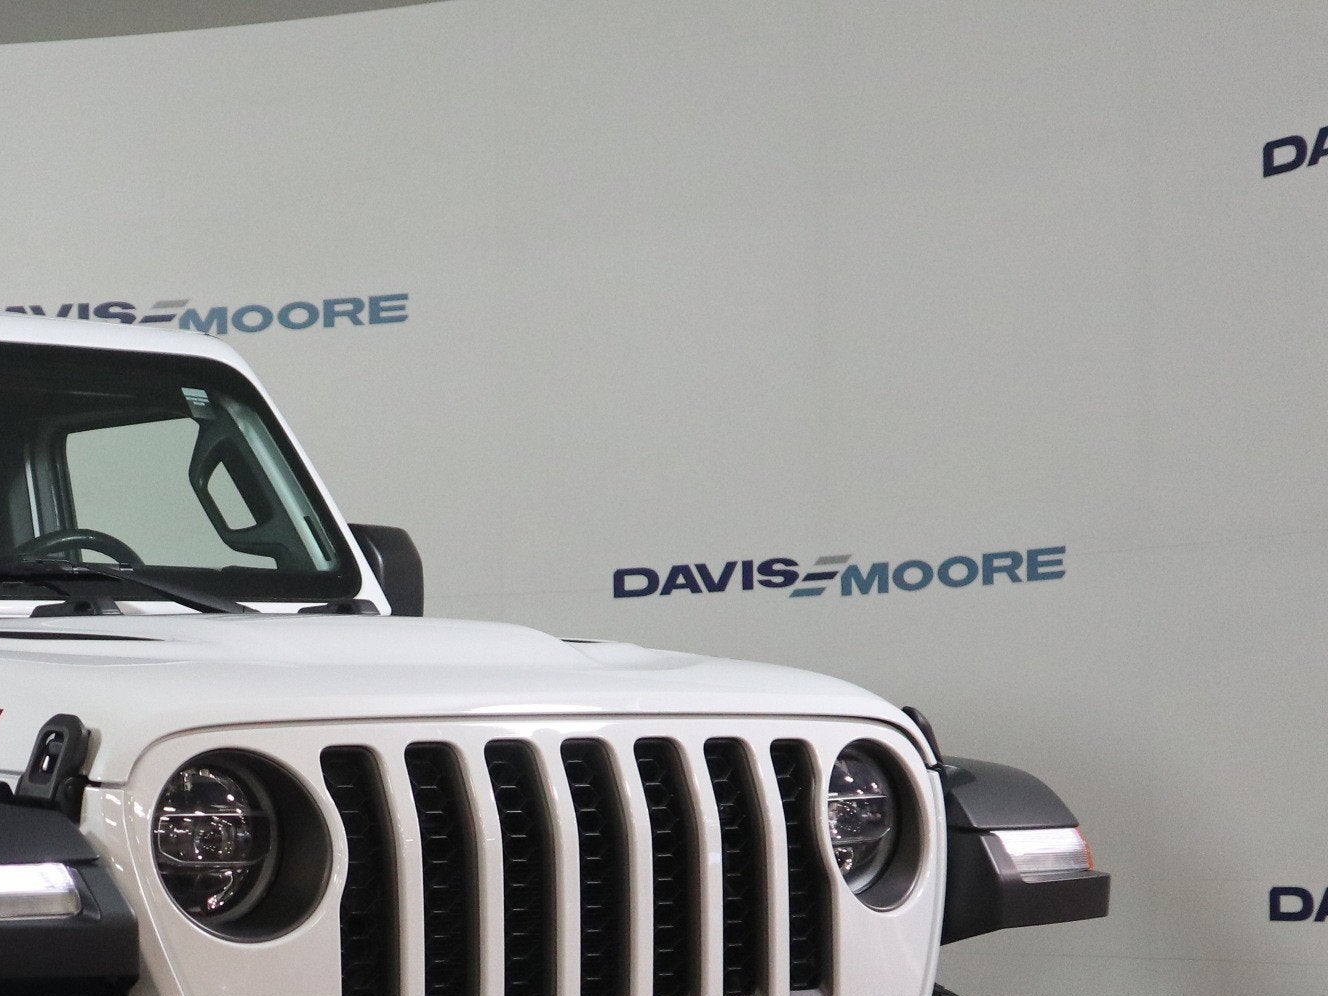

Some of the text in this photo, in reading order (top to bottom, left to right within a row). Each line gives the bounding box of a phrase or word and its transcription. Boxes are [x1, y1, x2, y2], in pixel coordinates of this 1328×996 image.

[178, 293, 409, 335] MOORE
[613, 545, 1066, 598] DAVIS MOORE
